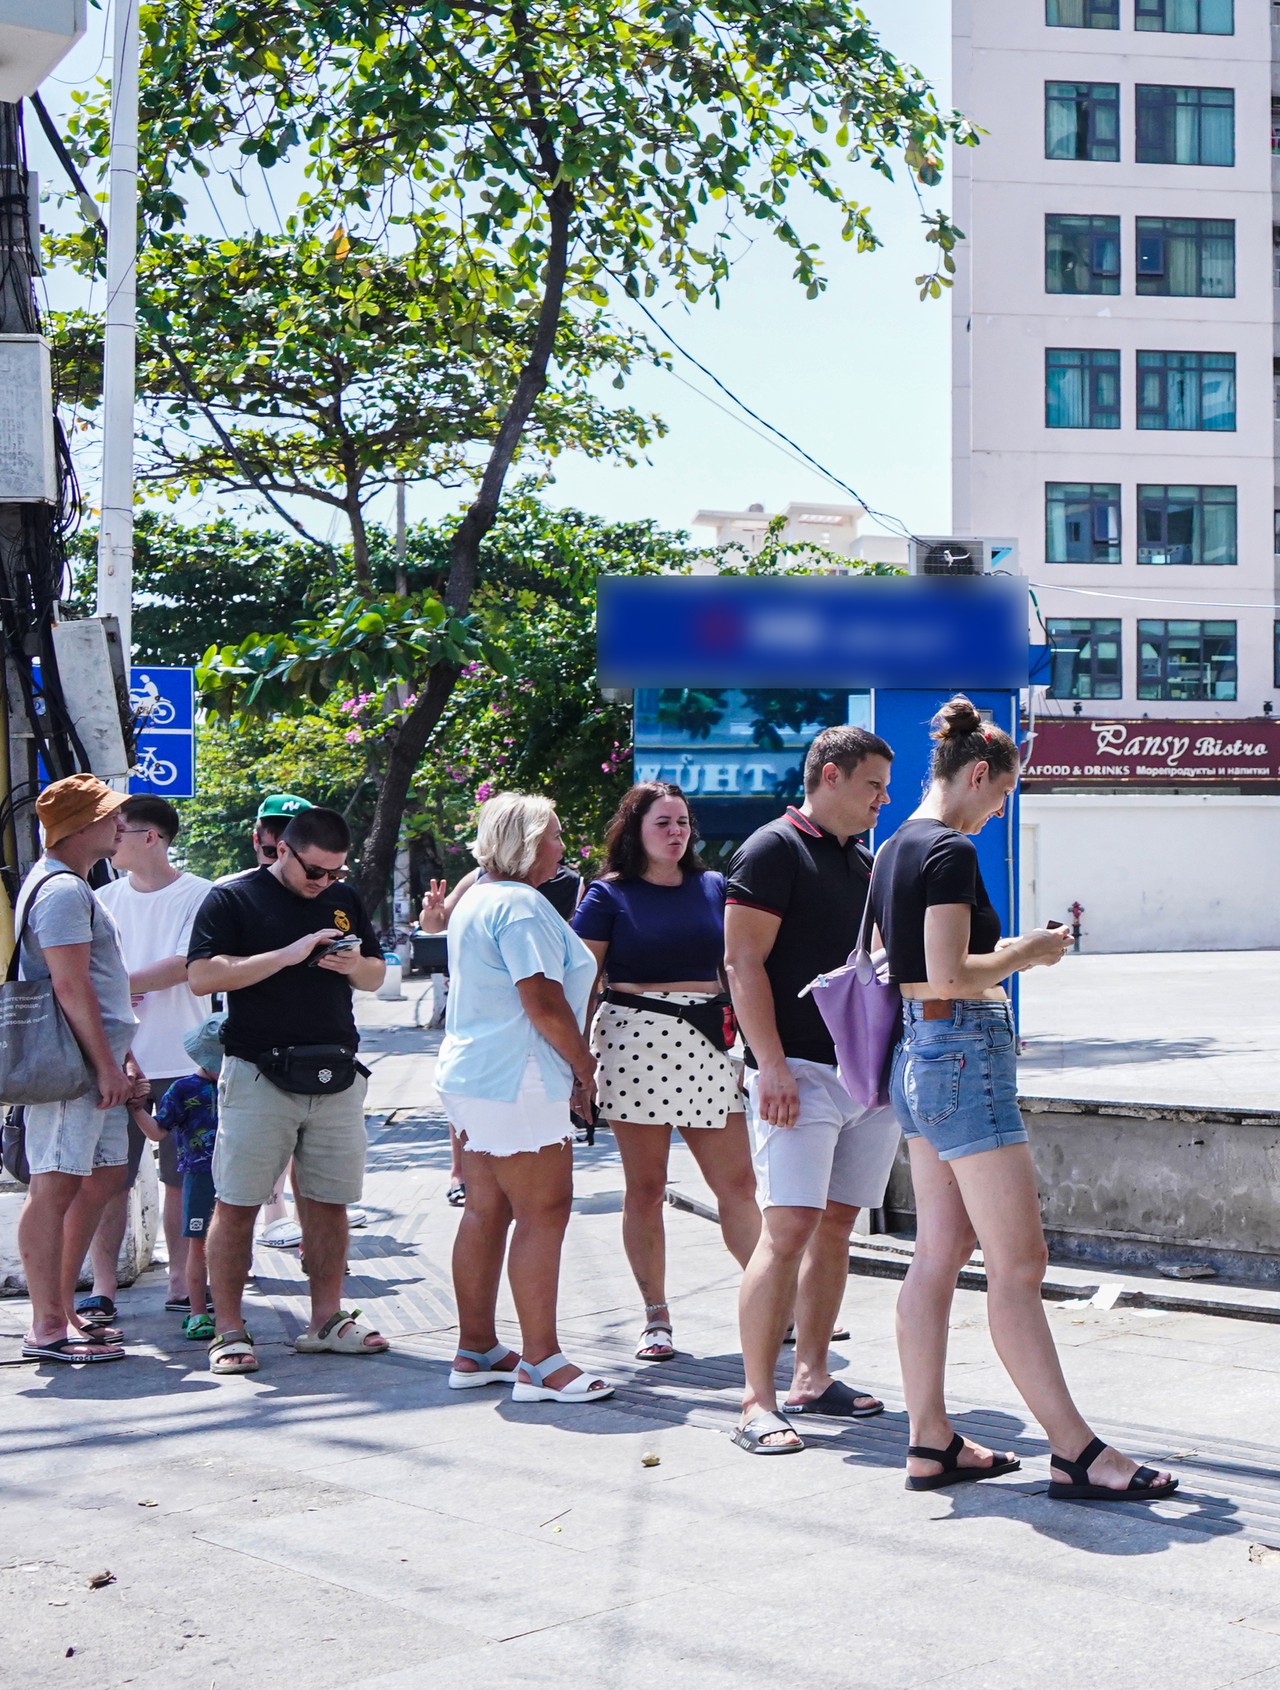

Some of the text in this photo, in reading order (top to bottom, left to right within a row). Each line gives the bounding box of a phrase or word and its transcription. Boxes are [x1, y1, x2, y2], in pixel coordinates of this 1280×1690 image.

[1091, 722, 1268, 767] Pansy Bistro
[1020, 765, 1131, 776] EAFOOD & DRINKS
[1136, 765, 1216, 777] Морепродукты
[1227, 767, 1270, 776] напитки
